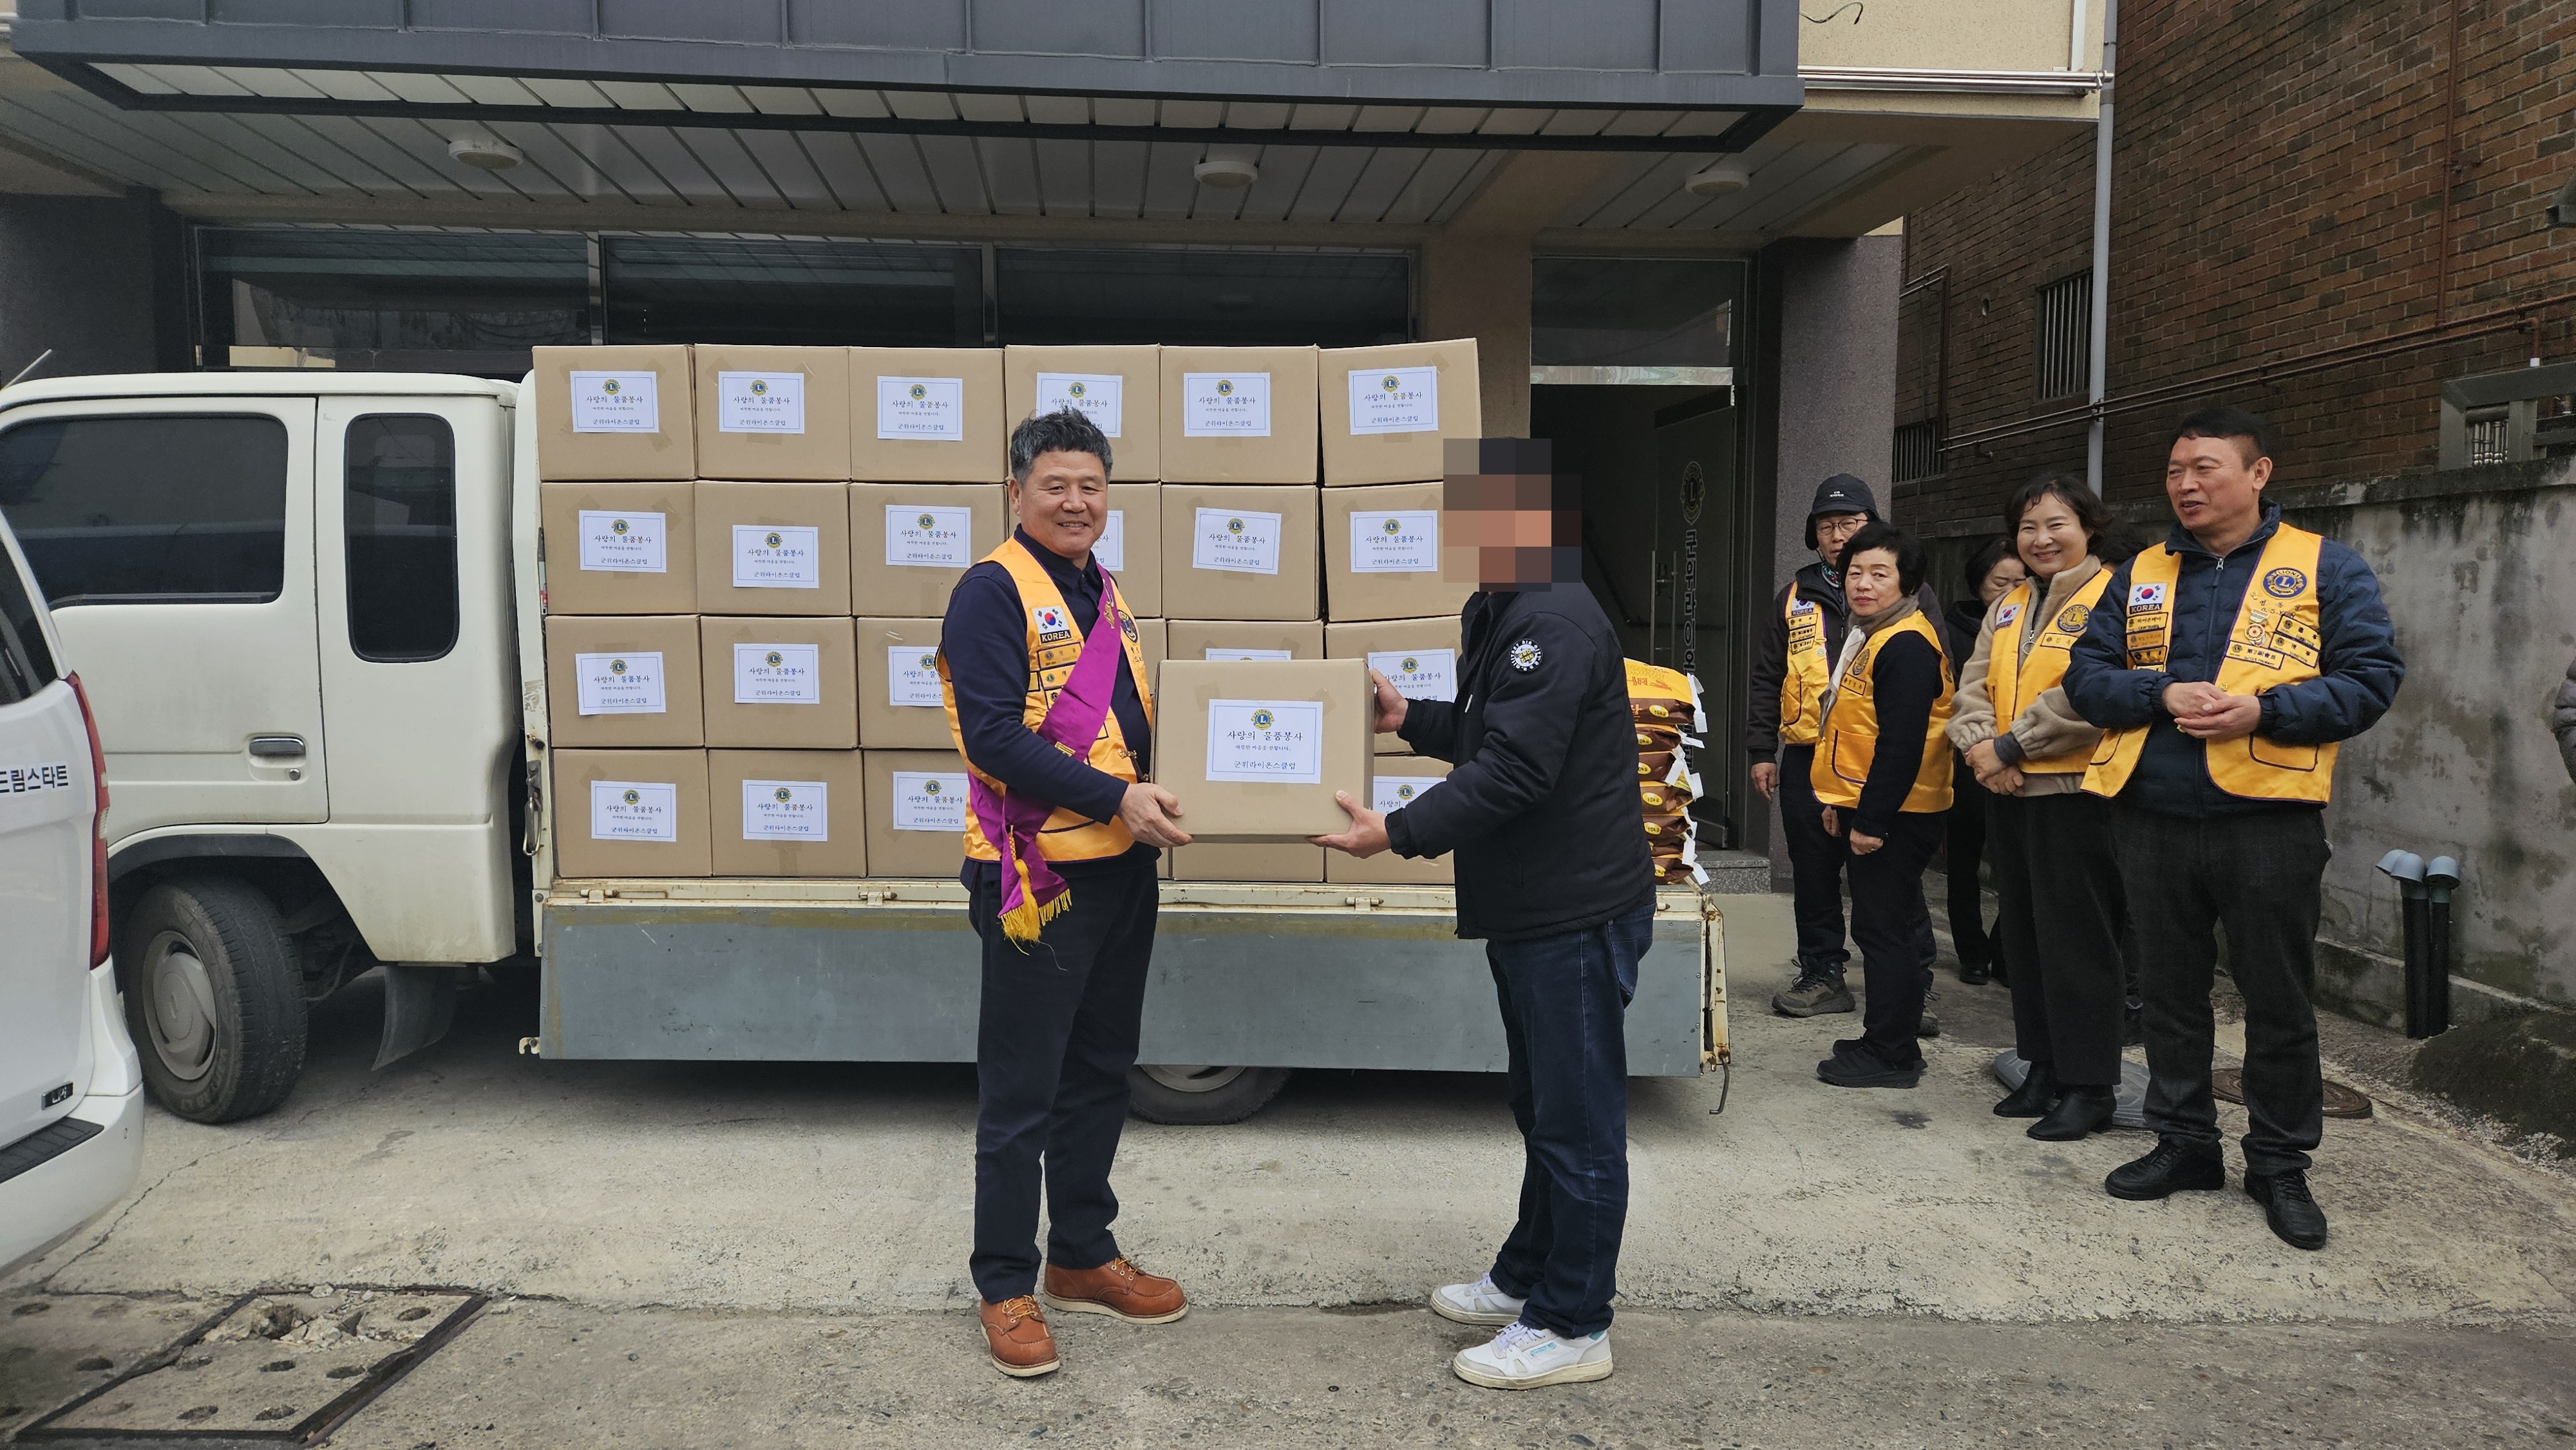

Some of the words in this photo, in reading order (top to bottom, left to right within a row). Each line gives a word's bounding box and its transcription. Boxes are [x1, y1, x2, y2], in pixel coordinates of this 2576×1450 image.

[1392, 391, 1423, 400] 물품봉사
[1078, 399, 1108, 408] 물품봉사
[1370, 415, 1419, 424] 군위라이온스클럽
[1209, 534, 1230, 542] 사랑의
[1236, 536, 1265, 545] 물품봉사
[1213, 556, 1260, 566] 군위라이온스클럽
[2278, 570, 2299, 578] LIONS
[2279, 576, 2290, 587] L
[2131, 604, 2160, 613] KOREA
[1041, 631, 1071, 643] KOREA
[1227, 731, 1255, 740] 사랑의
[1264, 731, 1303, 742] 물품봉사
[1234, 761, 1296, 770] 군위라이온스클럽
